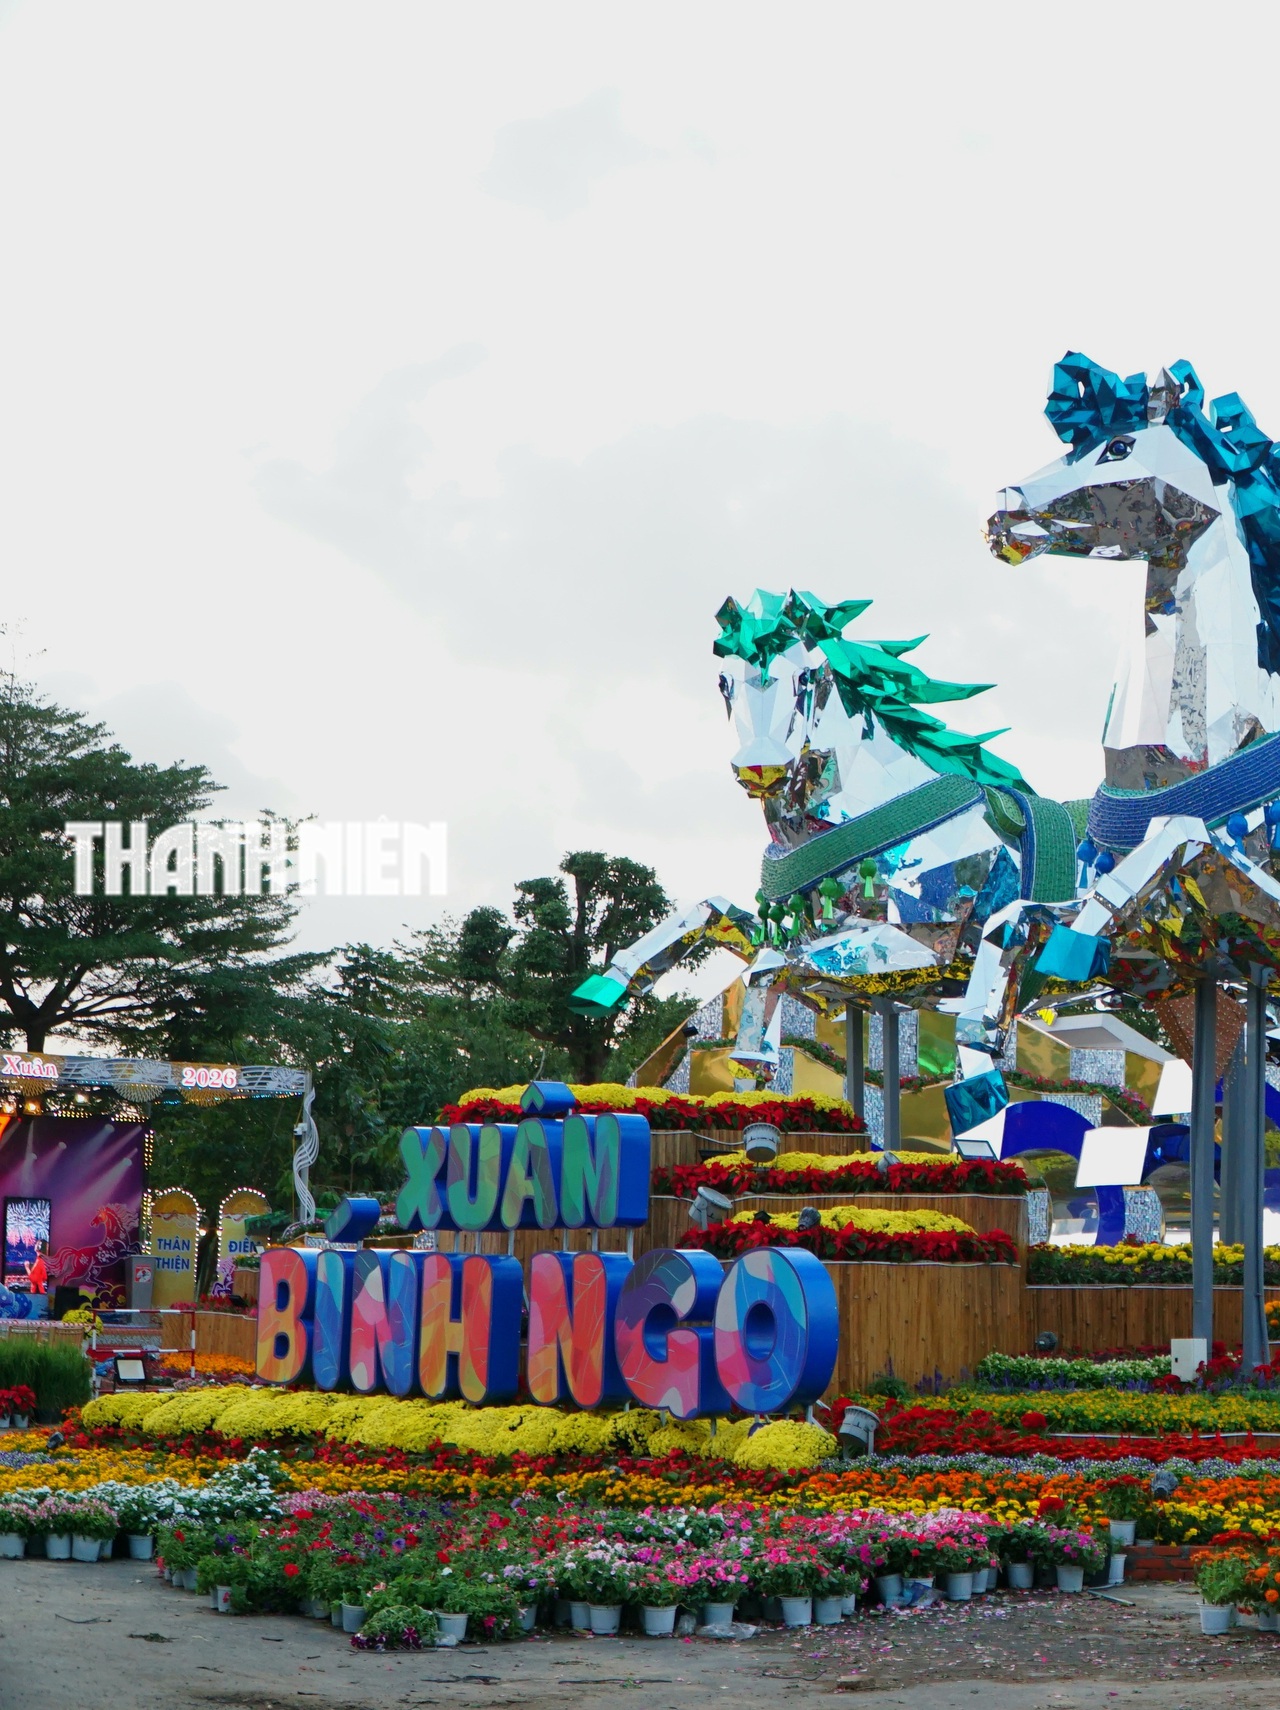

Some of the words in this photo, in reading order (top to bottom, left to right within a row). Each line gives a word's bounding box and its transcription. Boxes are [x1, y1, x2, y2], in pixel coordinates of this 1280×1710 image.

[1, 1054, 60, 1079] Xuân
[181, 1067, 238, 1089] 2026
[396, 1080, 650, 1232] XUÂN
[157, 1235, 191, 1252] THÂN
[155, 1255, 190, 1273] THIỆN
[255, 1197, 524, 1407] BÍNH
